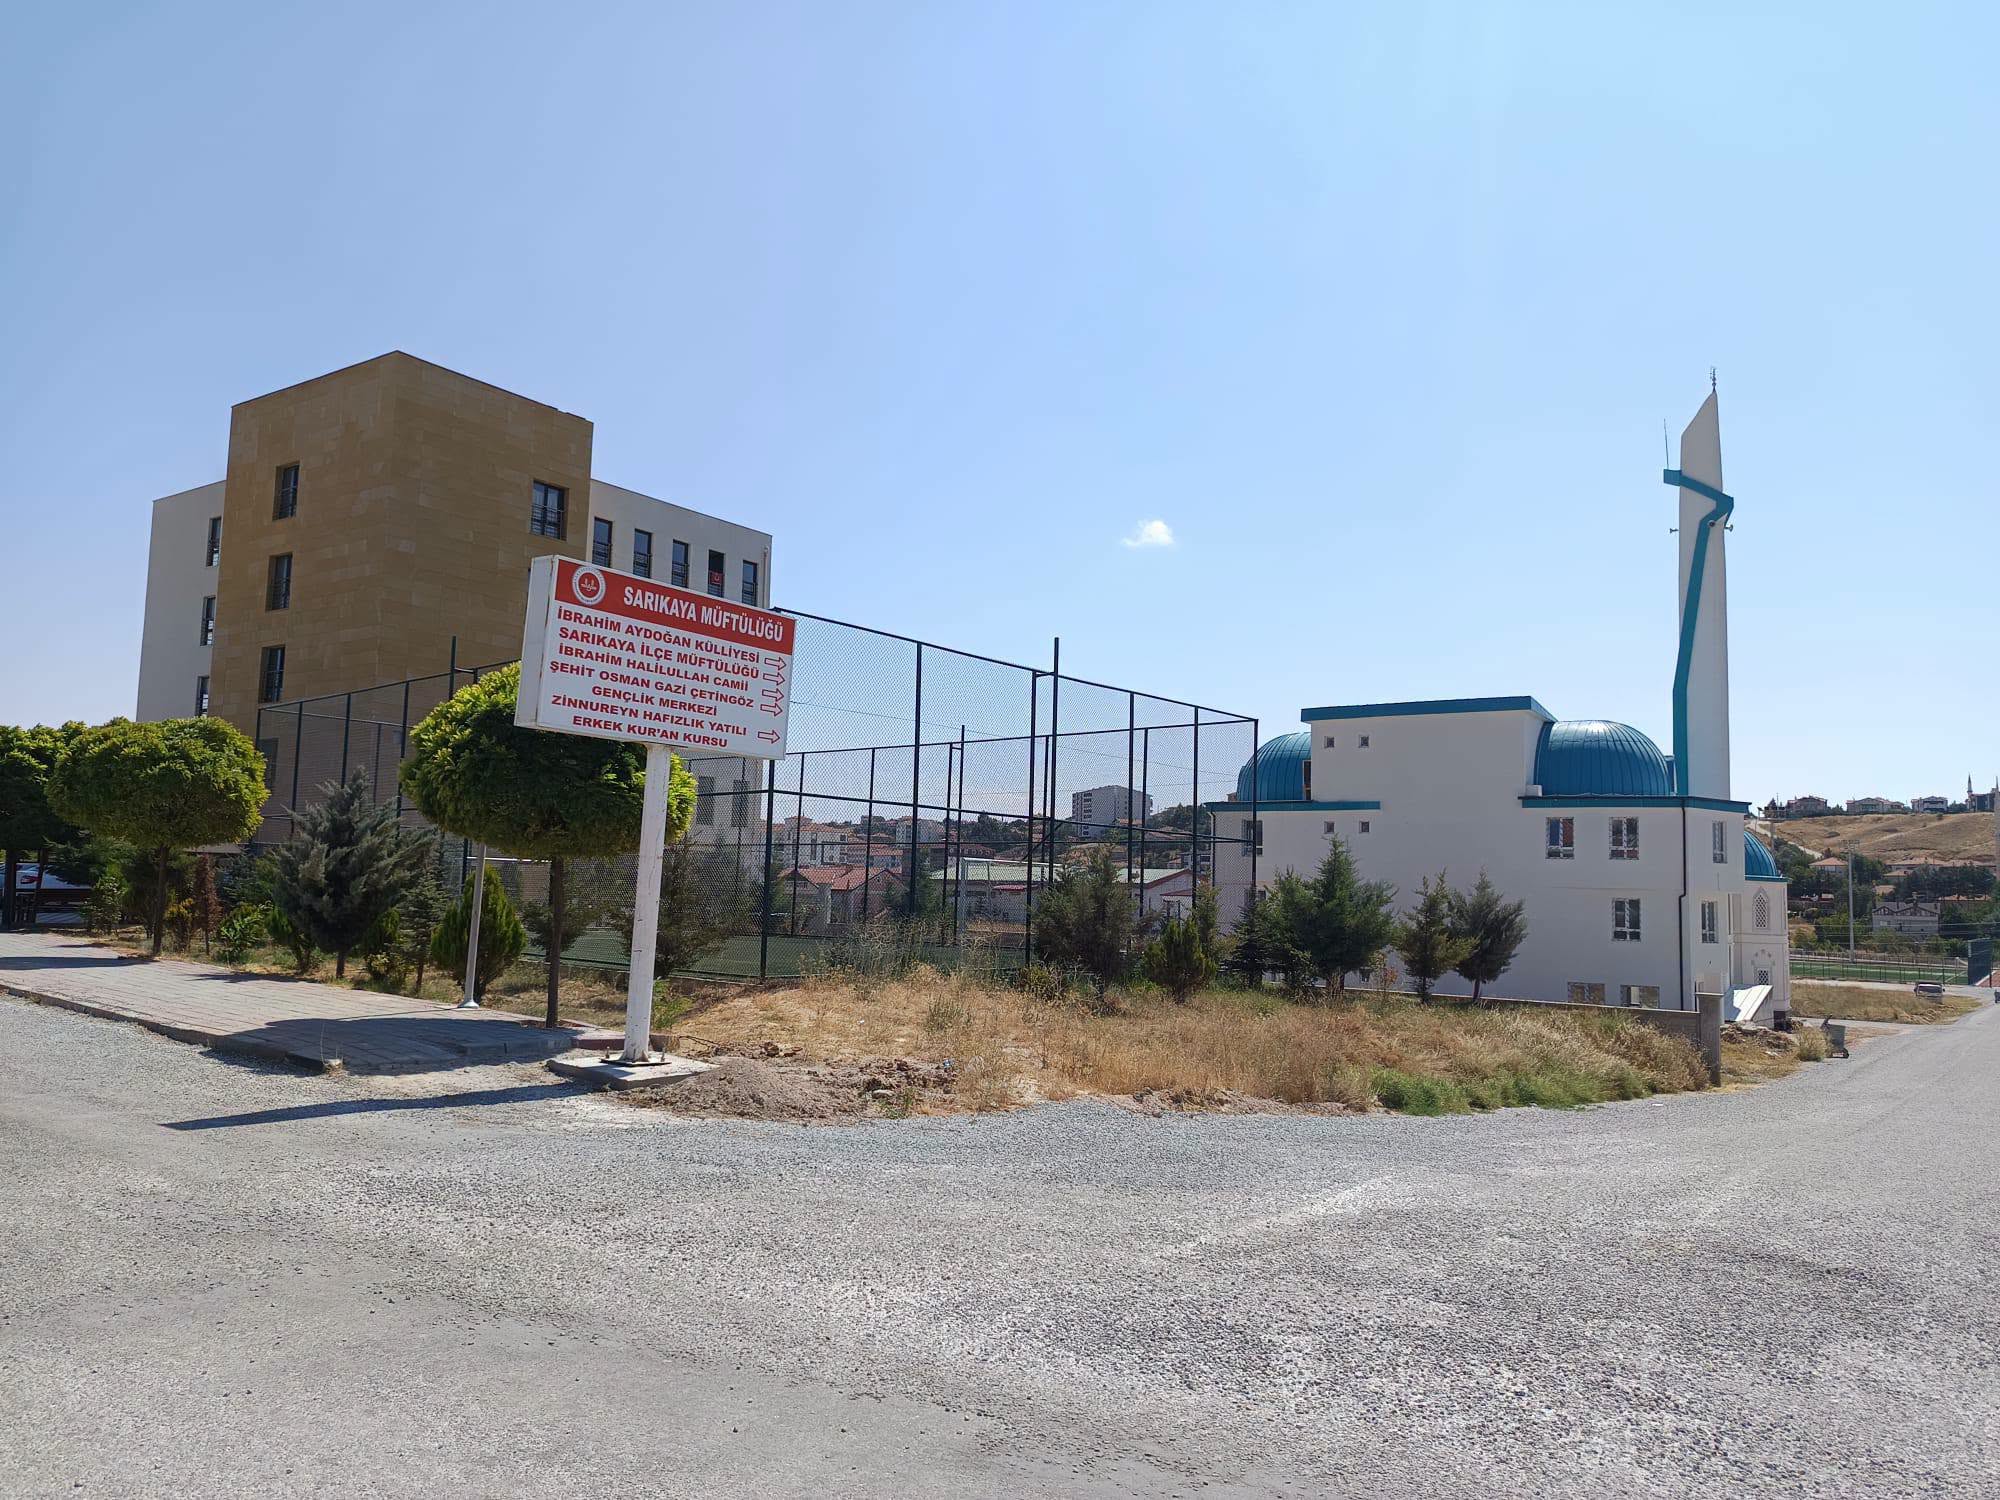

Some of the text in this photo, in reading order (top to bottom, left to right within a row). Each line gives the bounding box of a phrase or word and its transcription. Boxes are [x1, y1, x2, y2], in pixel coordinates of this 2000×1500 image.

[558, 606, 760, 663] İBRAHİM AYDOĞAN KÜLLİYESİ
[623, 586, 783, 641] SARIKAYA MÜFTÜLÜĞÜ
[559, 627, 759, 678] SARIKAYA İLÇE MÜFTÜLÜĞÜ
[559, 643, 748, 691] İBRAHİM HALİLULLAH CAMİİ
[550, 661, 754, 707] ŞEHİT OSMAN GAZİ ÇETİNGÖZ
[592, 686, 717, 716] GENÇLİK MERKEZİ
[552, 694, 747, 735] ZİNNUREYN HAFIZLIK YATILI
[573, 715, 727, 747] ERKEK KUR'AN KURSU
